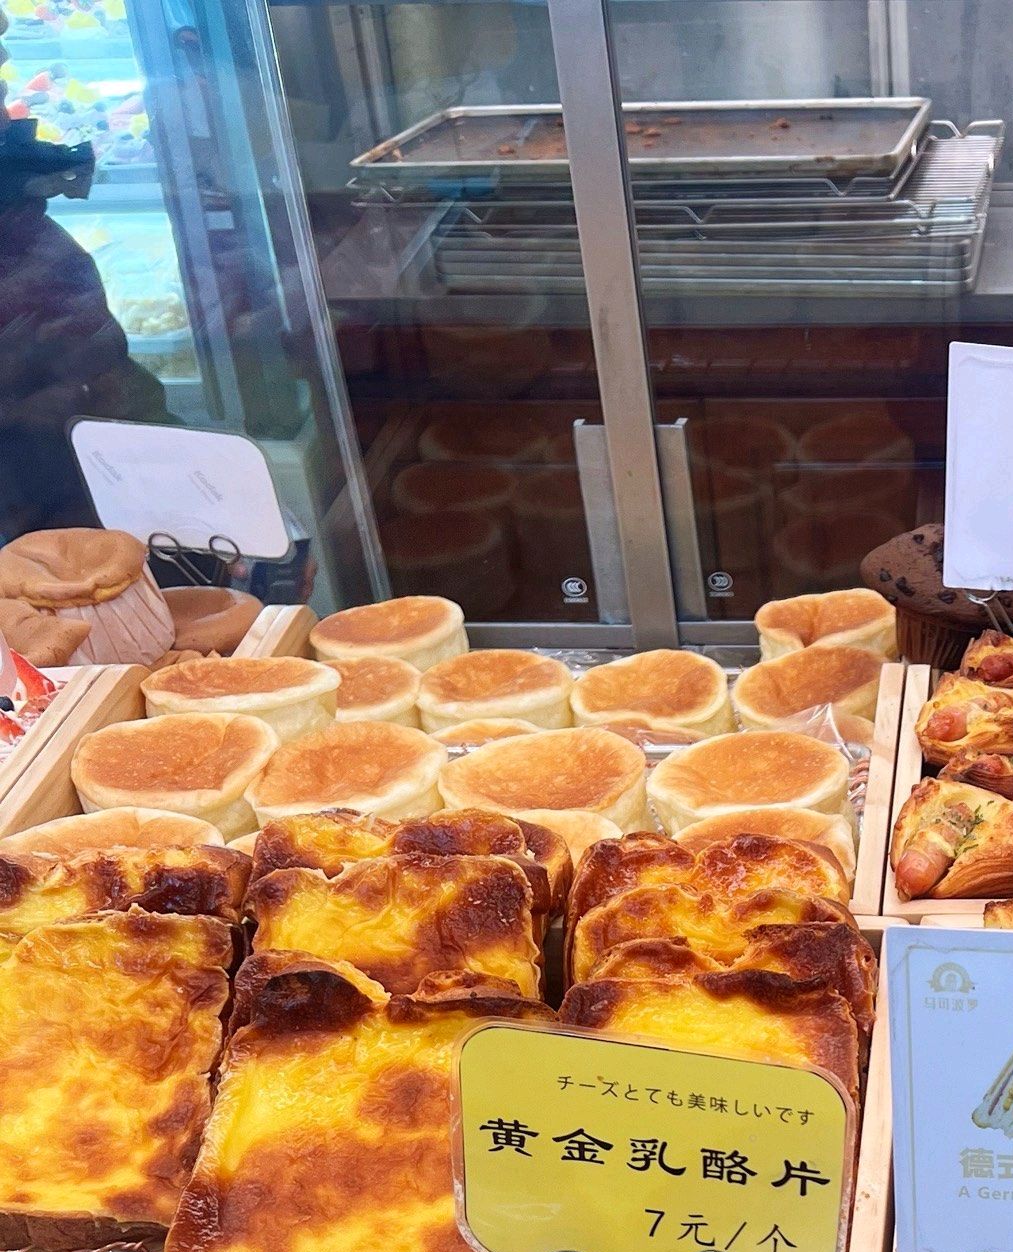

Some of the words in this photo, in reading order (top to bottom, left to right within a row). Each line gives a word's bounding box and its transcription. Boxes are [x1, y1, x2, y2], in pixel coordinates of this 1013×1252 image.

[556, 1074, 815, 1126] チーズとても美味しいです
[478, 1117, 831, 1197] 黄金乳酪片
[958, 1185, 970, 1198] A
